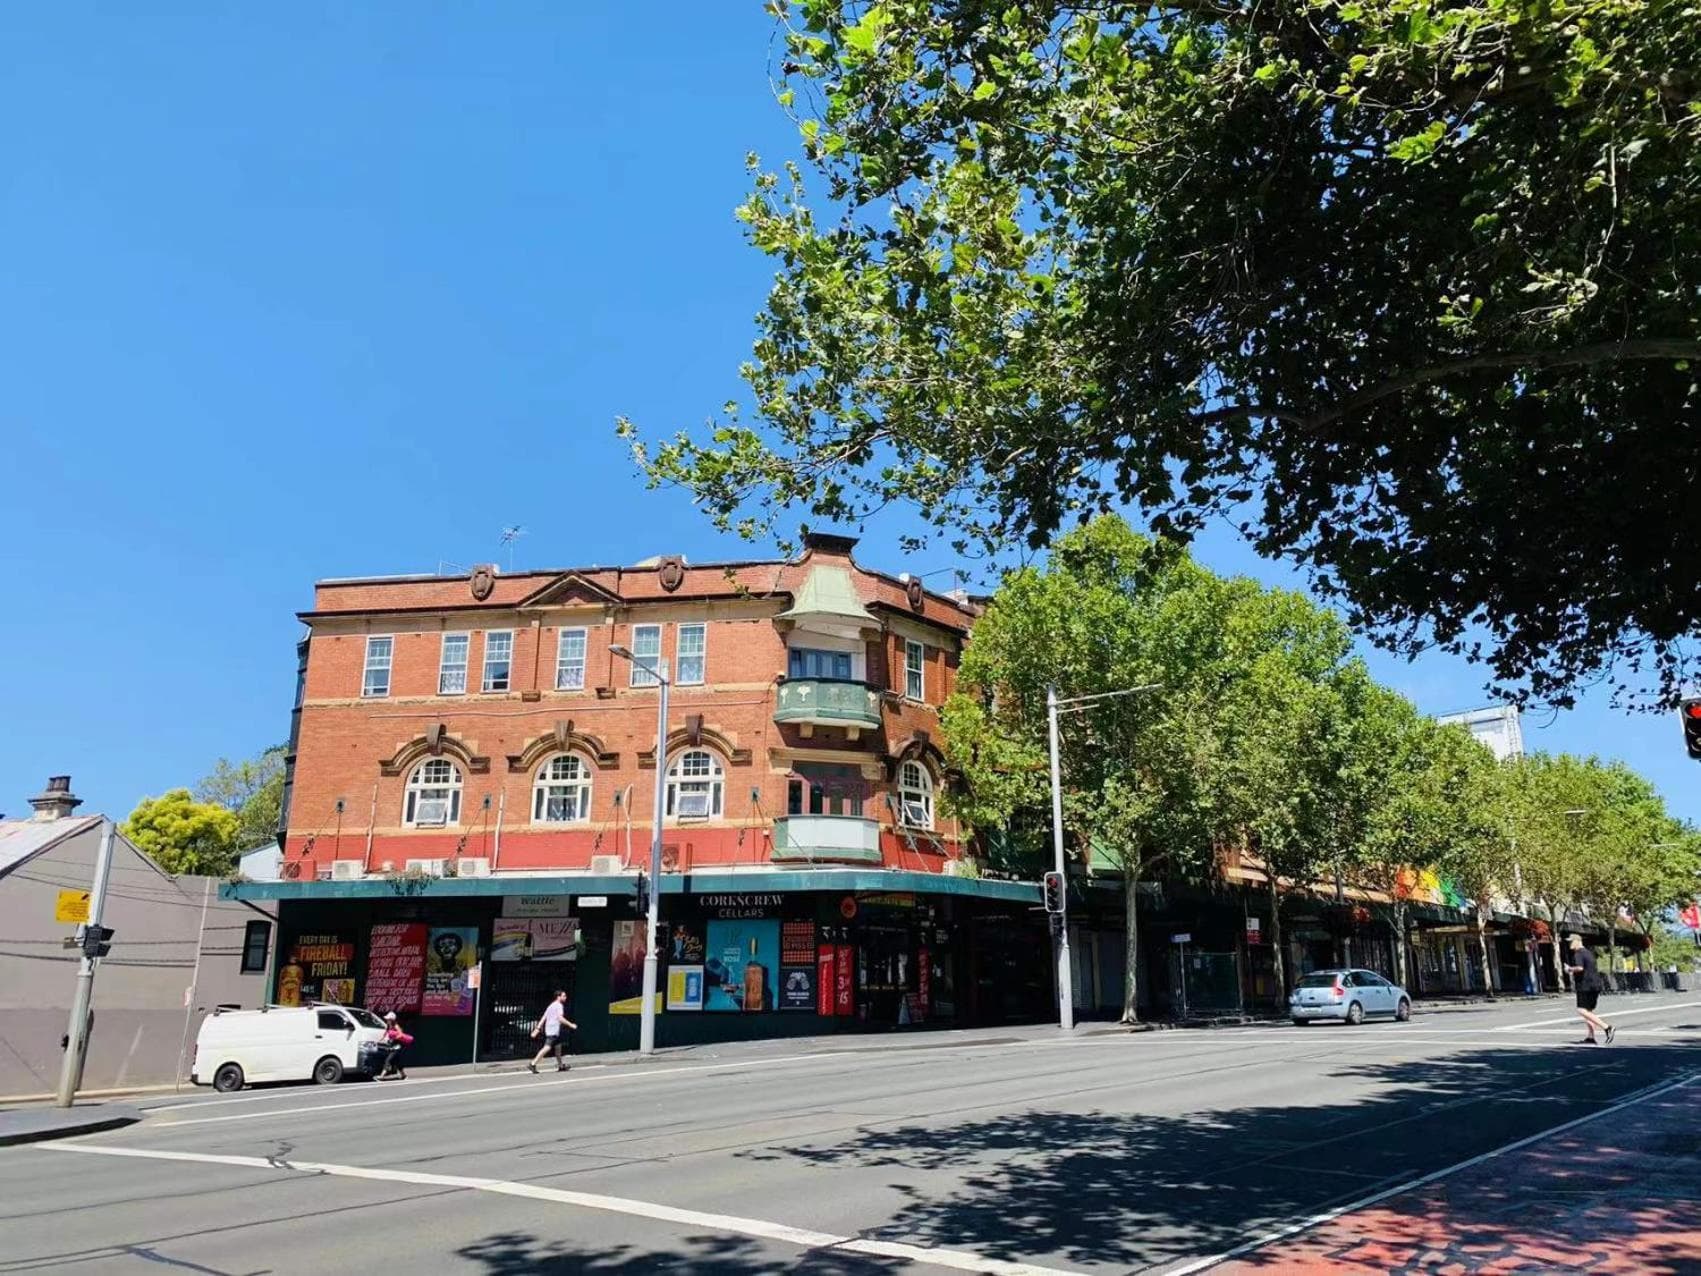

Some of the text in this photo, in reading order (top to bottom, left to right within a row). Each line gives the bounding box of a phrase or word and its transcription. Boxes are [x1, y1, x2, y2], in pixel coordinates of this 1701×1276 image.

[699, 895, 783, 906] CORKSCREW
[718, 908, 765, 918] CELLARS
[299, 935, 318, 944] EVERY
[319, 935, 330, 944] DAY
[301, 945, 345, 961] FIREBALL
[312, 962, 347, 977] FRIDAY!
